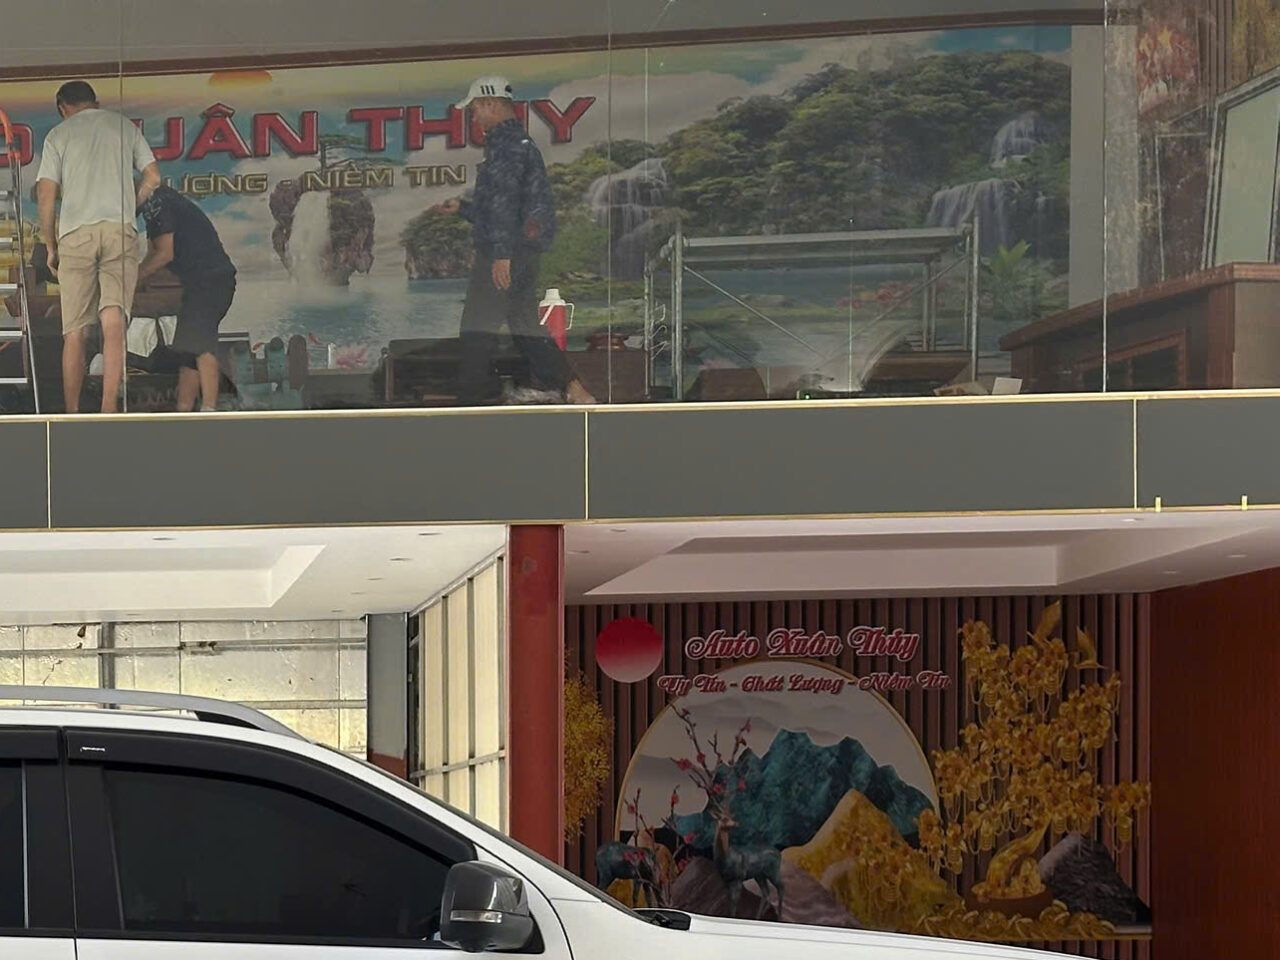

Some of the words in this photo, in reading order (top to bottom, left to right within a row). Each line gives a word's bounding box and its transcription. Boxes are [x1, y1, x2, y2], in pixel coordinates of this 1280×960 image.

[135, 102, 320, 161] UÂN
[407, 165, 467, 187] TIN
[685, 629, 760, 660] Auto
[766, 627, 843, 657] Xuân
